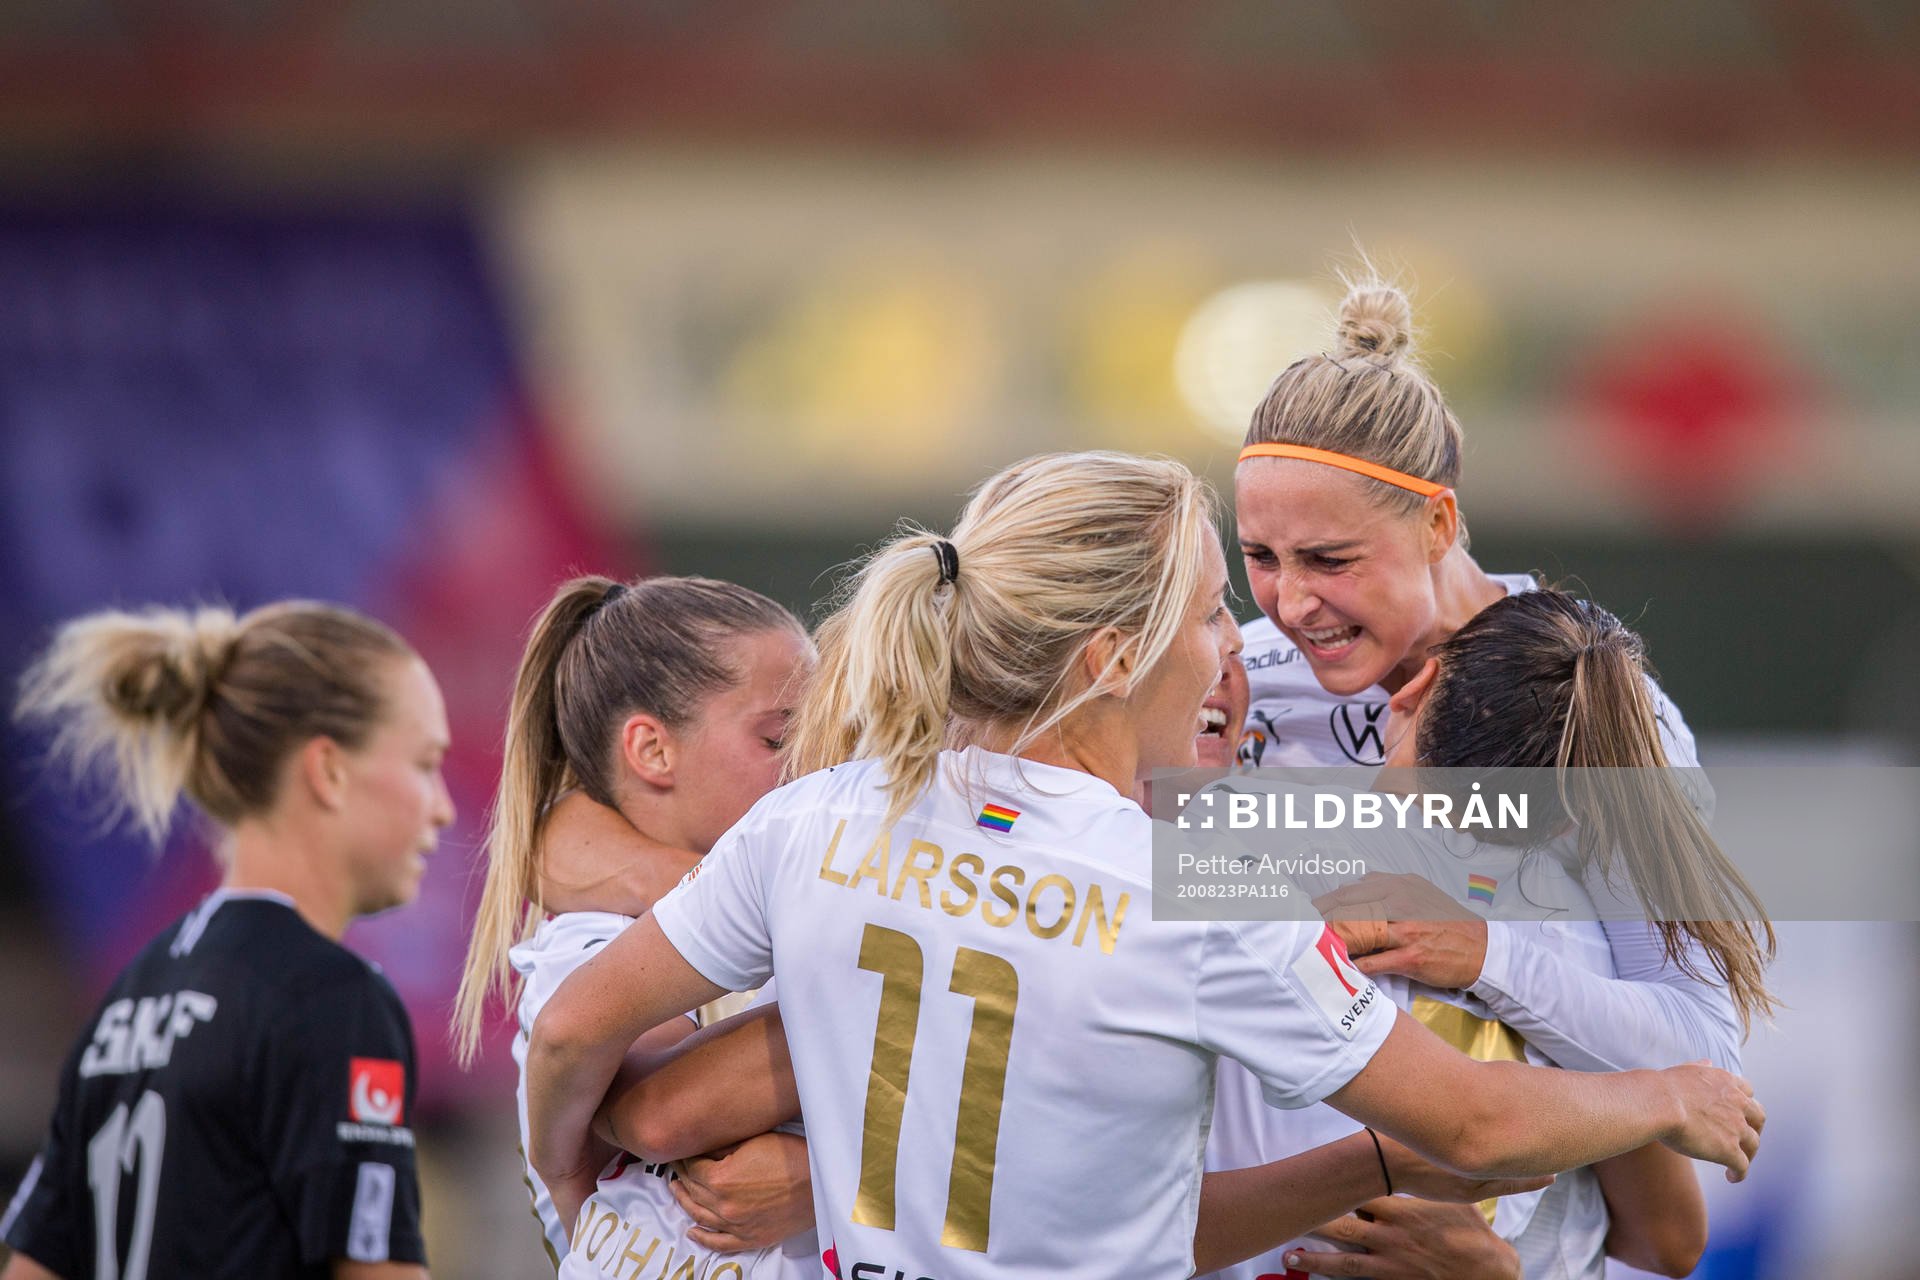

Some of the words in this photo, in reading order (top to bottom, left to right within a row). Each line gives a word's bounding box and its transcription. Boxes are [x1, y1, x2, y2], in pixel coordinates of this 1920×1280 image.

[1243, 648, 1300, 671] adium
[819, 818, 1131, 955] LARSSON
[79, 989, 218, 1078] SKF
[850, 922, 1018, 1254] 11
